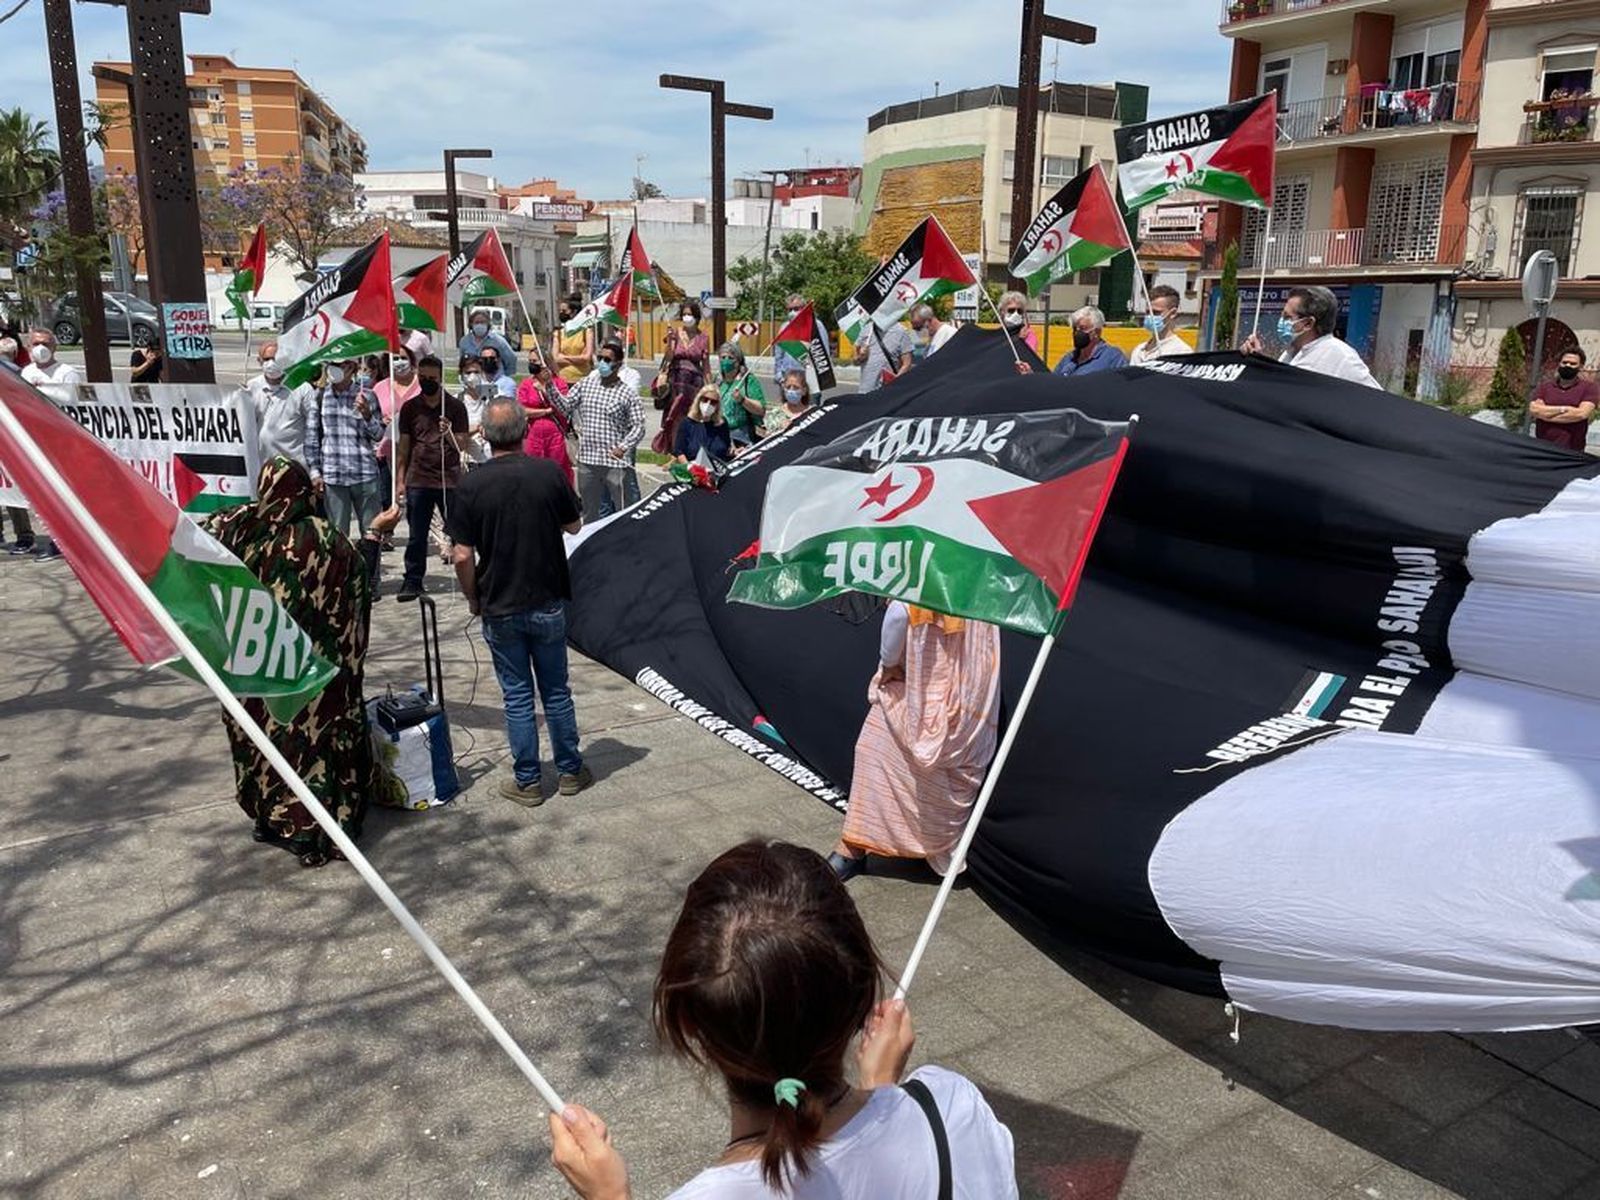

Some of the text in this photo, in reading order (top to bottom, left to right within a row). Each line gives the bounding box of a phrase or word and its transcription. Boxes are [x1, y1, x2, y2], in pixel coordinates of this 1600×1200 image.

[810, 337, 830, 374] SAHARA
[134, 406, 170, 441] DEL
[171, 398, 244, 444] SÁHARA
